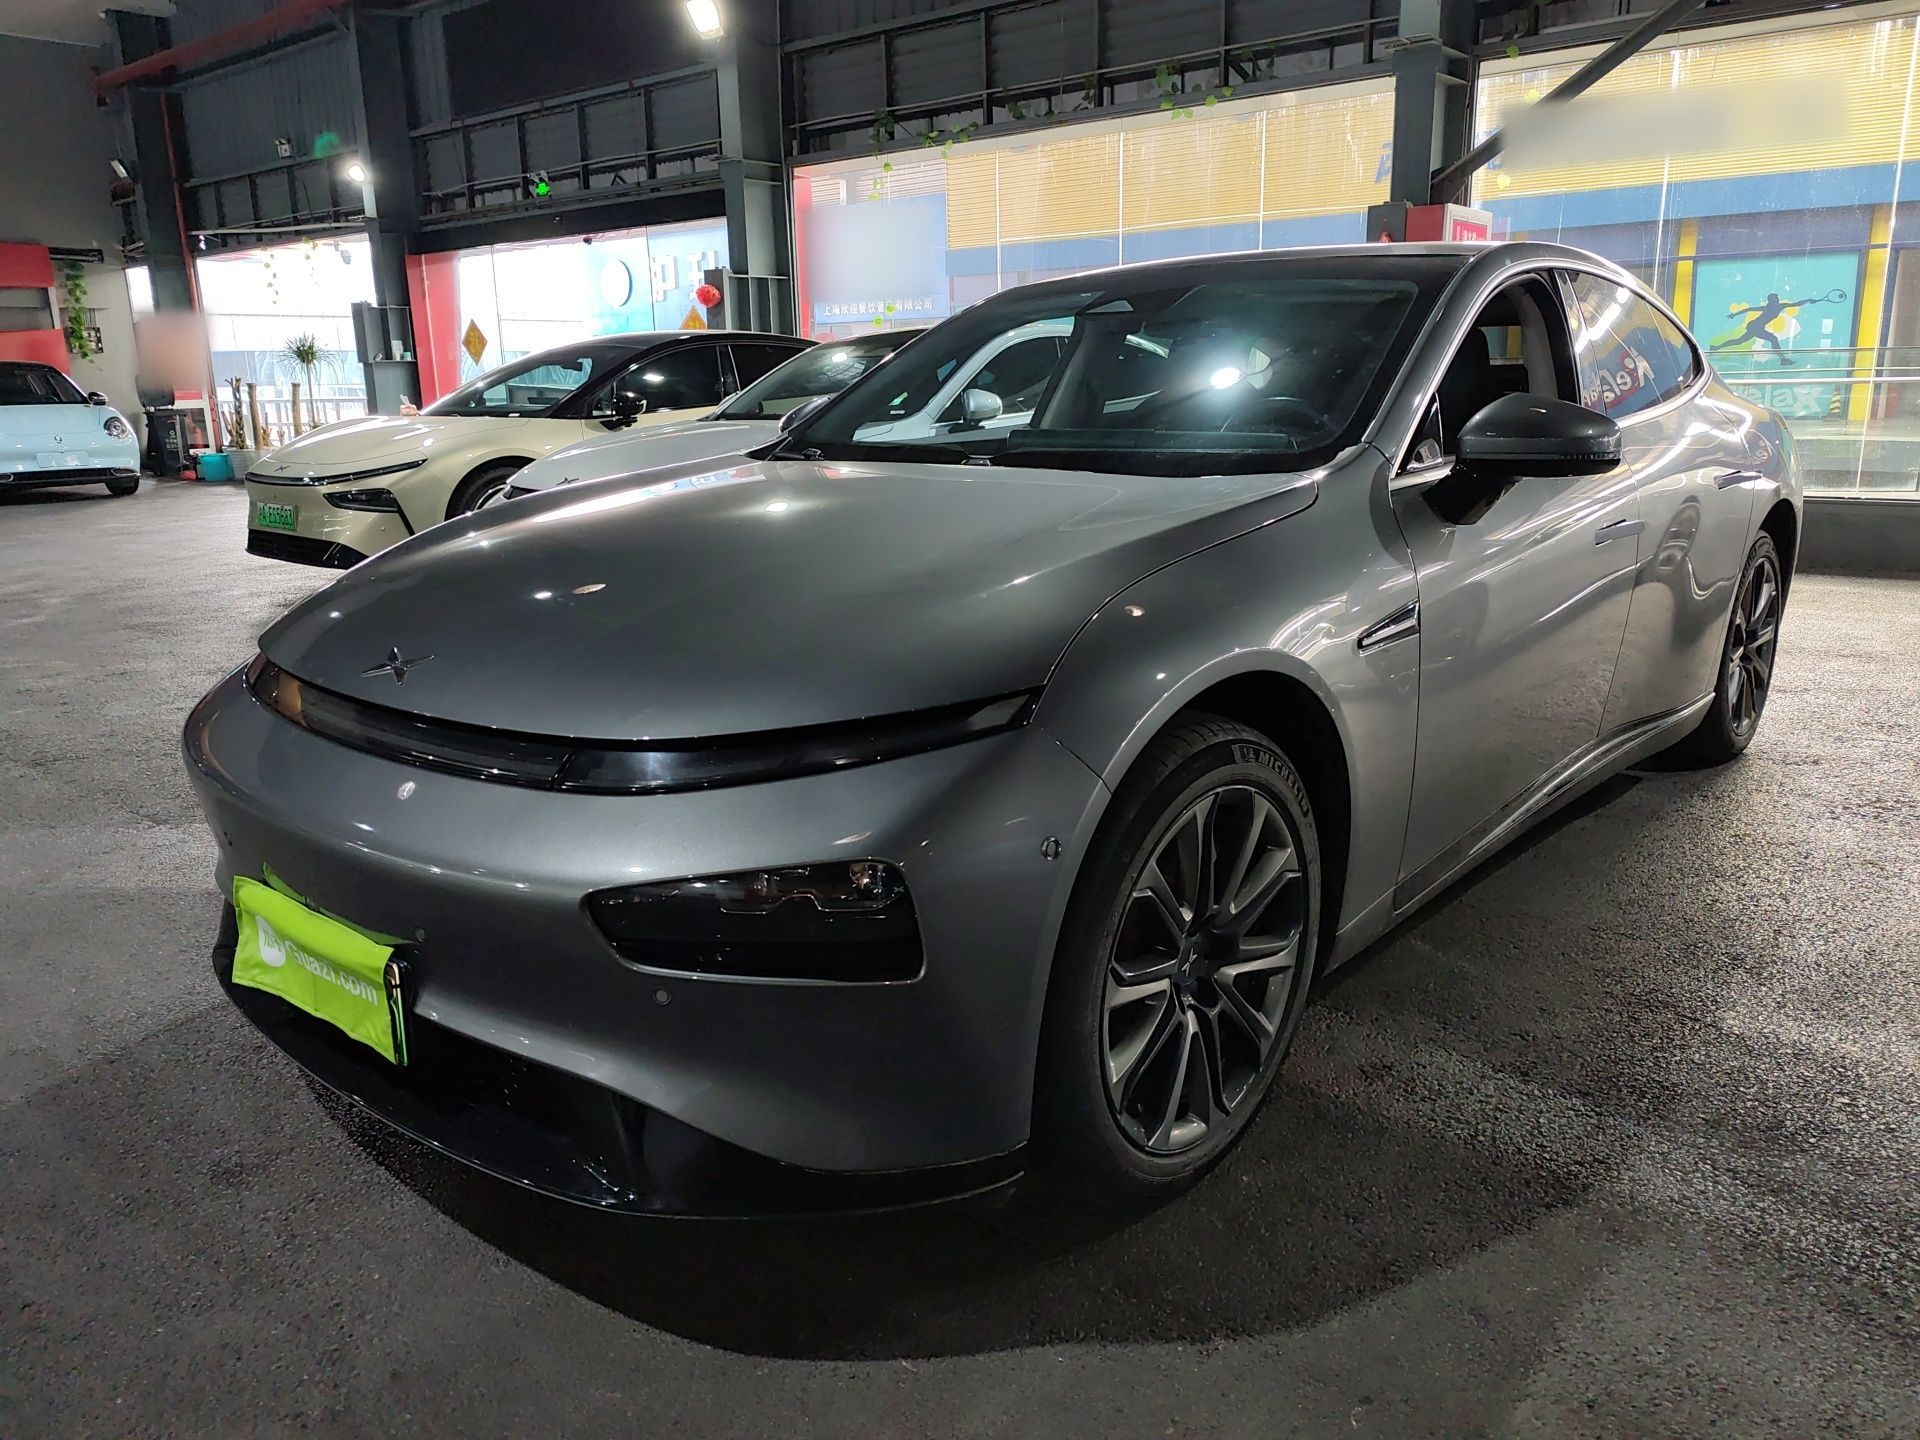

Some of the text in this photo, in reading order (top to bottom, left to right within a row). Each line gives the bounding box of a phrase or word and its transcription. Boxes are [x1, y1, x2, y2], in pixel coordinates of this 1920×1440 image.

[823, 297, 933, 316] 上海欣迎餐饮管有限公司
[1258, 750, 1310, 817] MICHELIN
